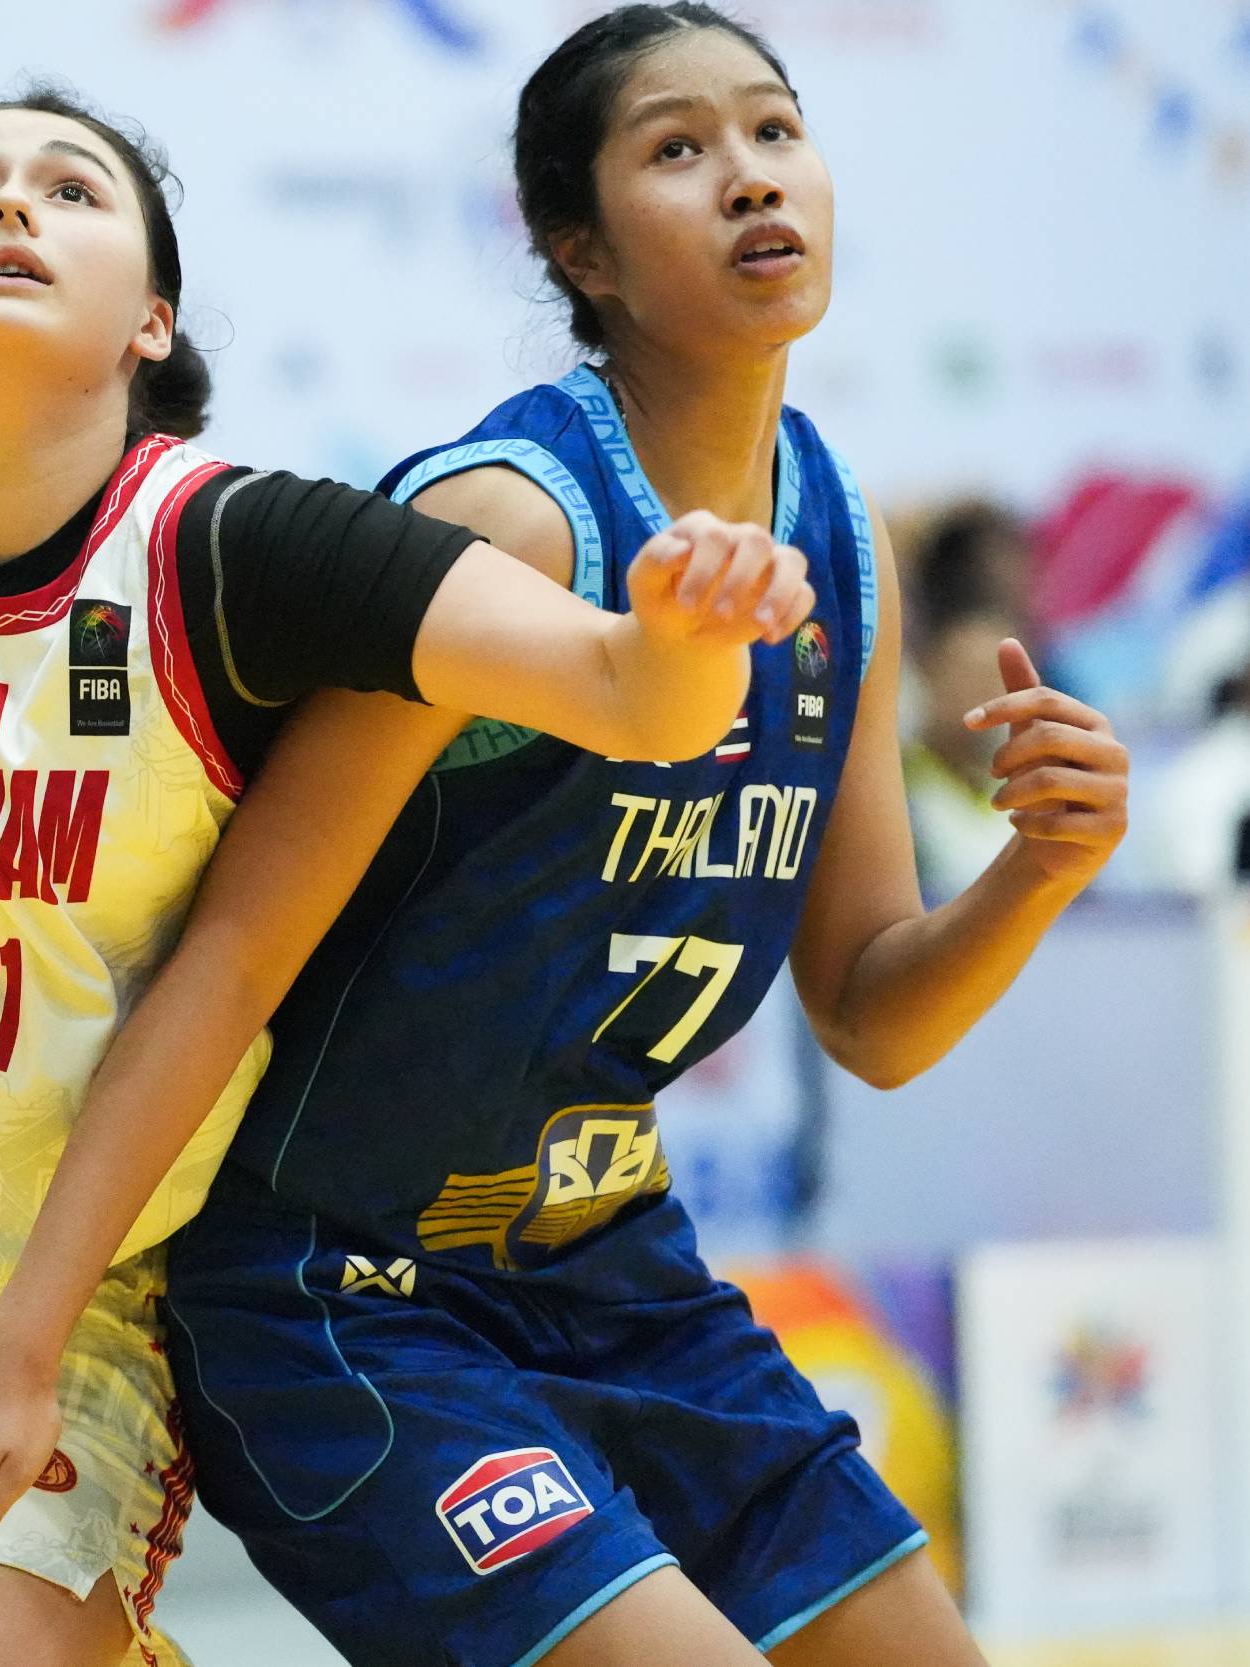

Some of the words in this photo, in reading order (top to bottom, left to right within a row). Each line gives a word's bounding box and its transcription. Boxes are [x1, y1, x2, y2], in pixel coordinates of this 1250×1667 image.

[79, 678, 121, 700] FIBA
[797, 694, 824, 718] FIBA
[592, 932, 745, 1064] 77
[454, 1470, 578, 1547] TOA
